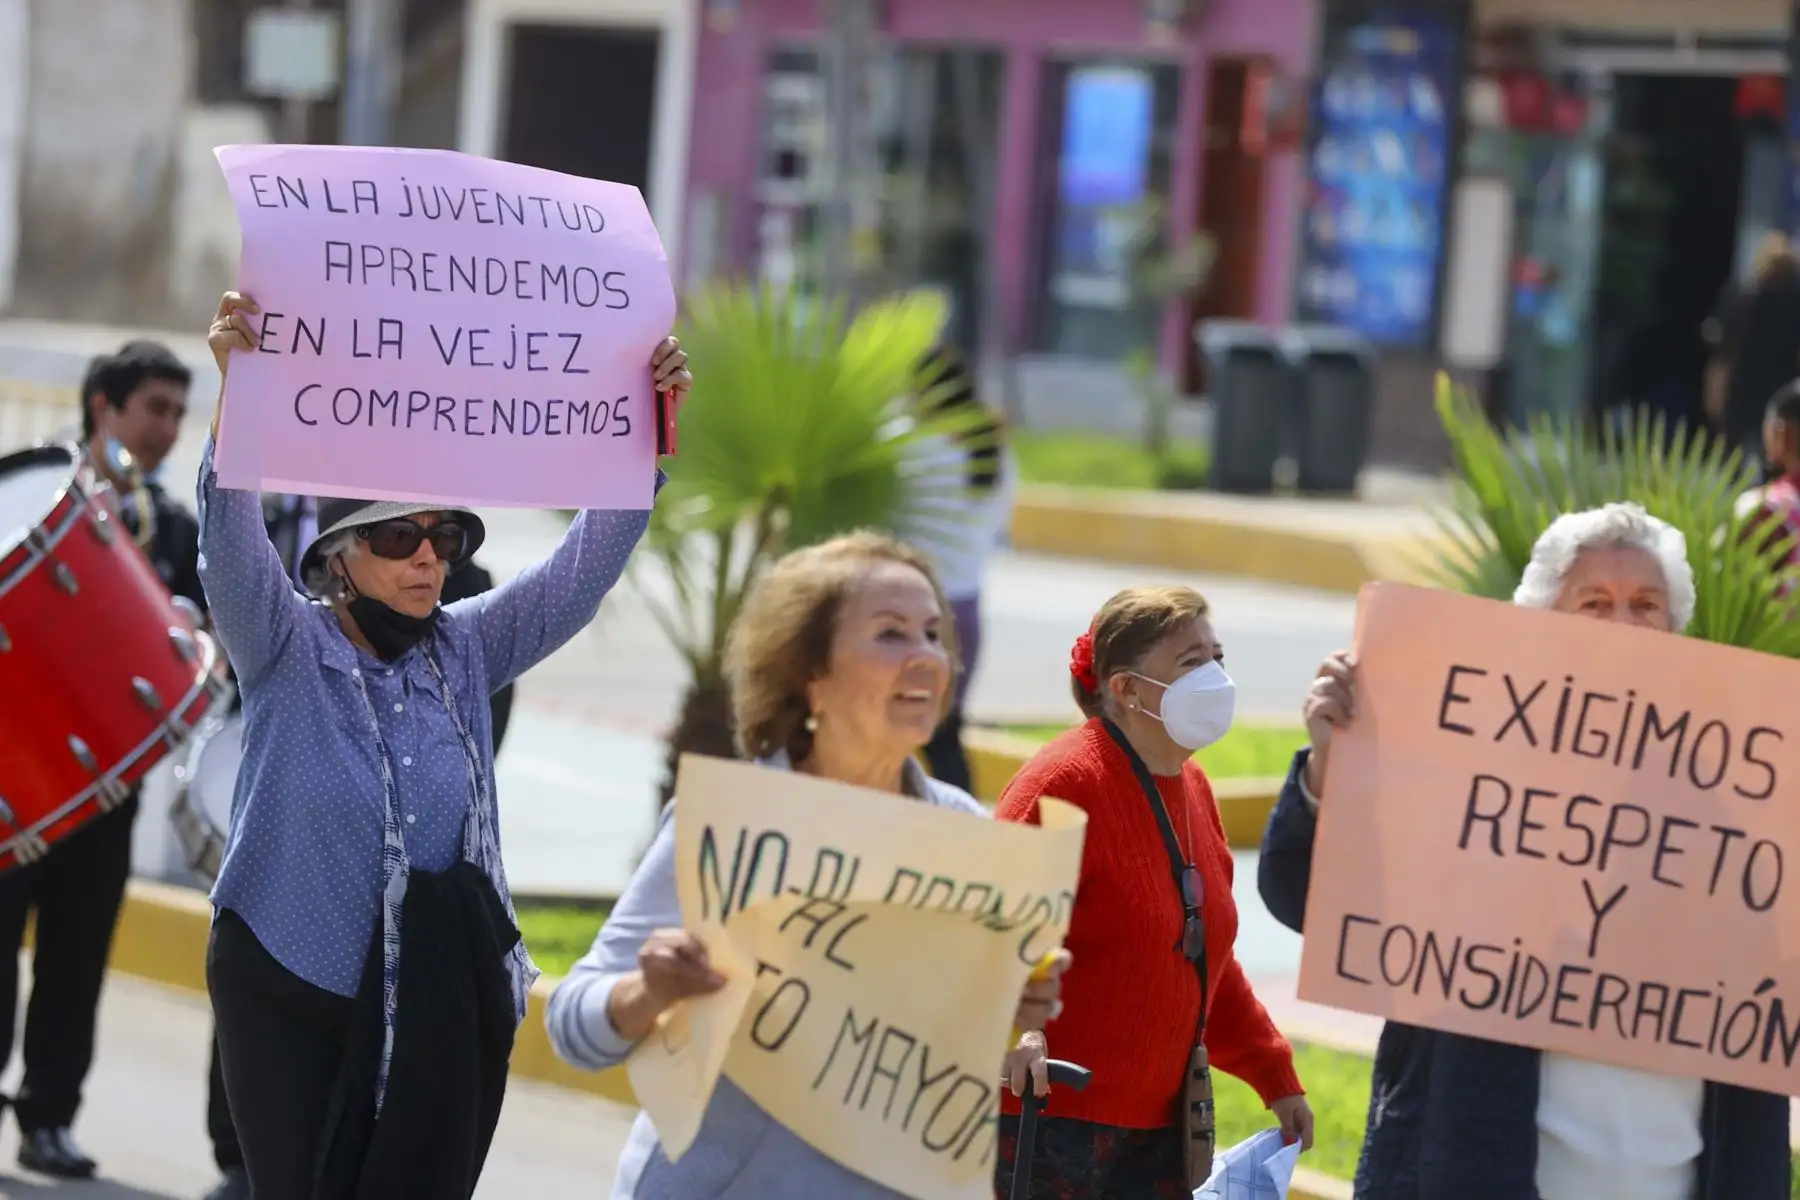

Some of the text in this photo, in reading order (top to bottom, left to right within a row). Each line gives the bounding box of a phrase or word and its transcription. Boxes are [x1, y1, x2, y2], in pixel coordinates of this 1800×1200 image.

[249, 174, 606, 234] EN LA JUVENTUD
[325, 241, 630, 310] APRENDEMOS
[258, 312, 590, 374] EN LA VEJEZ
[294, 383, 632, 437] COMPRENDEMOS
[1457, 774, 1784, 912] RESPETO
[1581, 878, 1629, 959] Y
